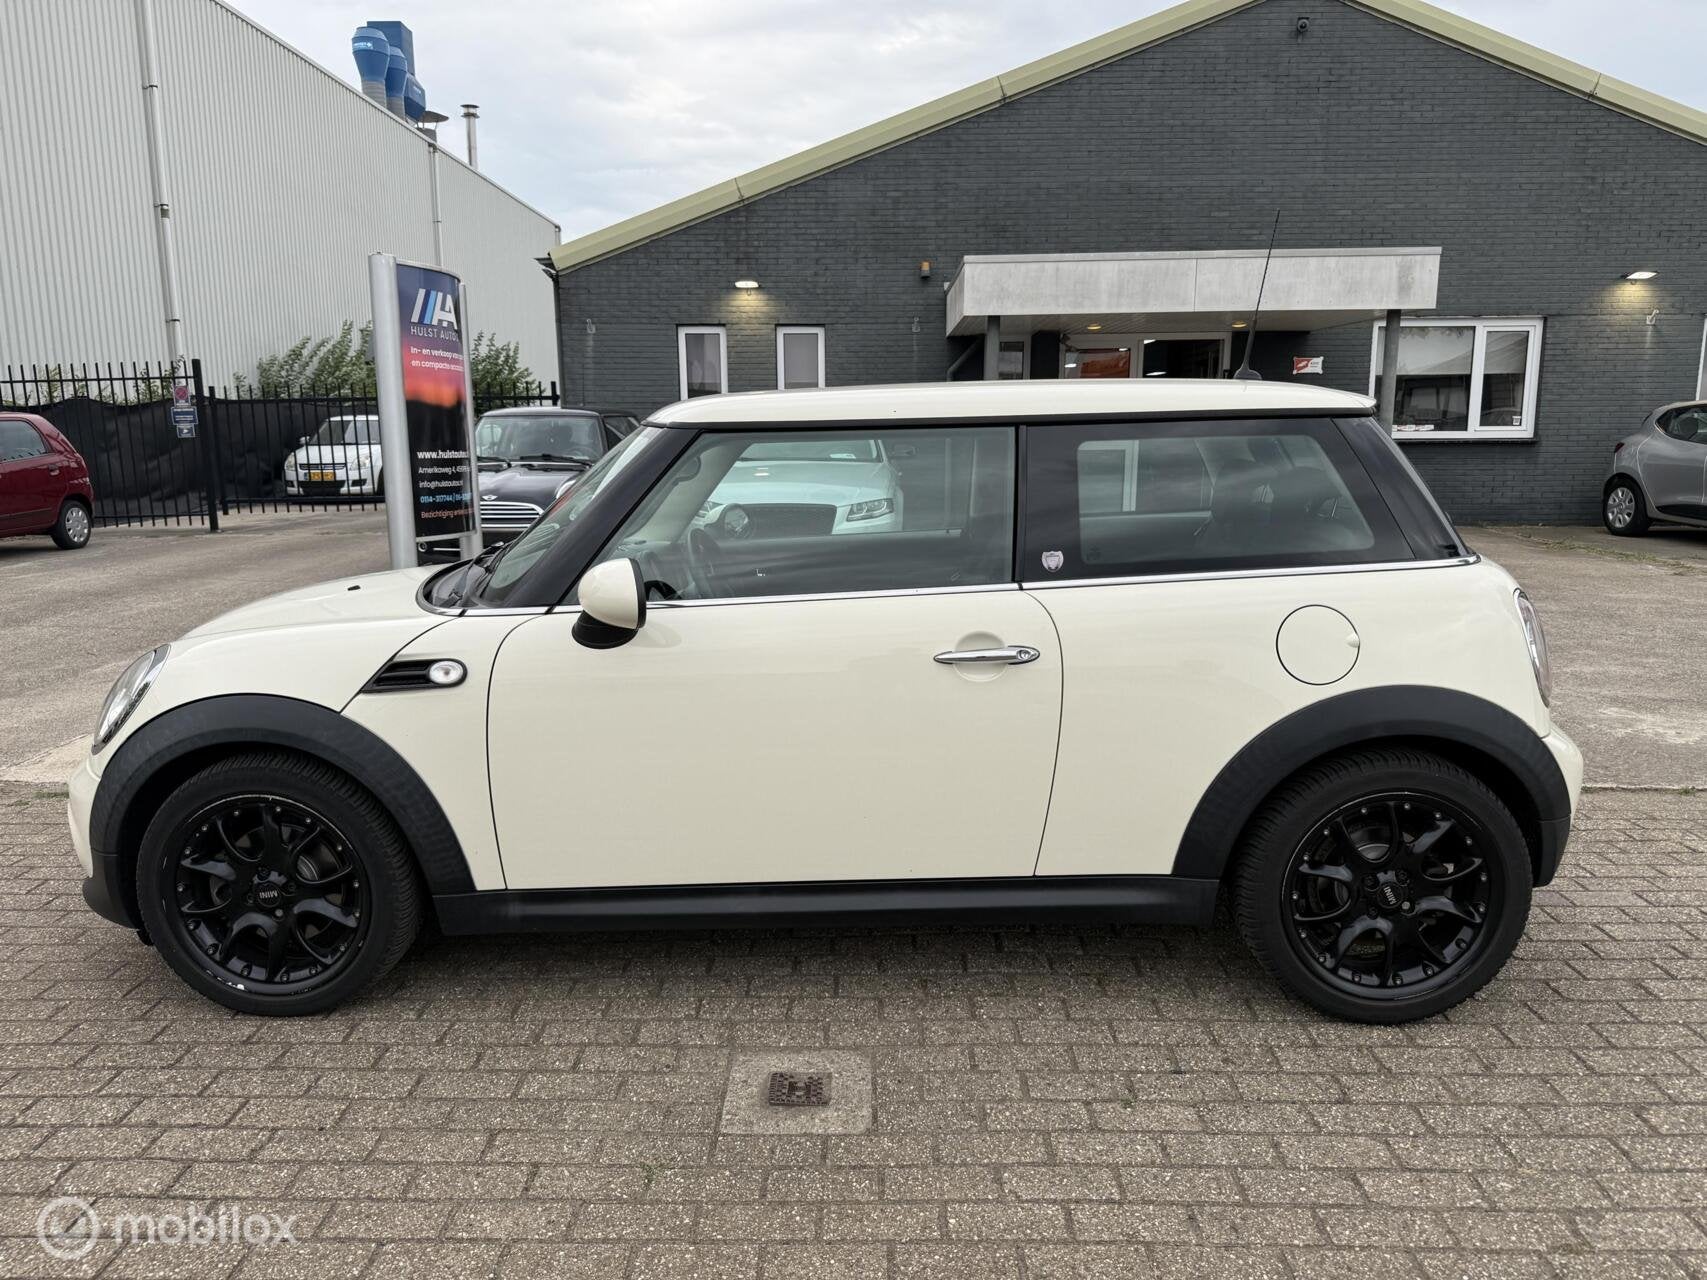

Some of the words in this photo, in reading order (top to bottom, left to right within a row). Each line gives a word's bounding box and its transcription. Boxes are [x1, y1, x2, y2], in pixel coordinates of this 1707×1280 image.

[410, 326, 438, 338] HULST
[422, 348, 431, 356] en
[259, 890, 278, 899] MINI
